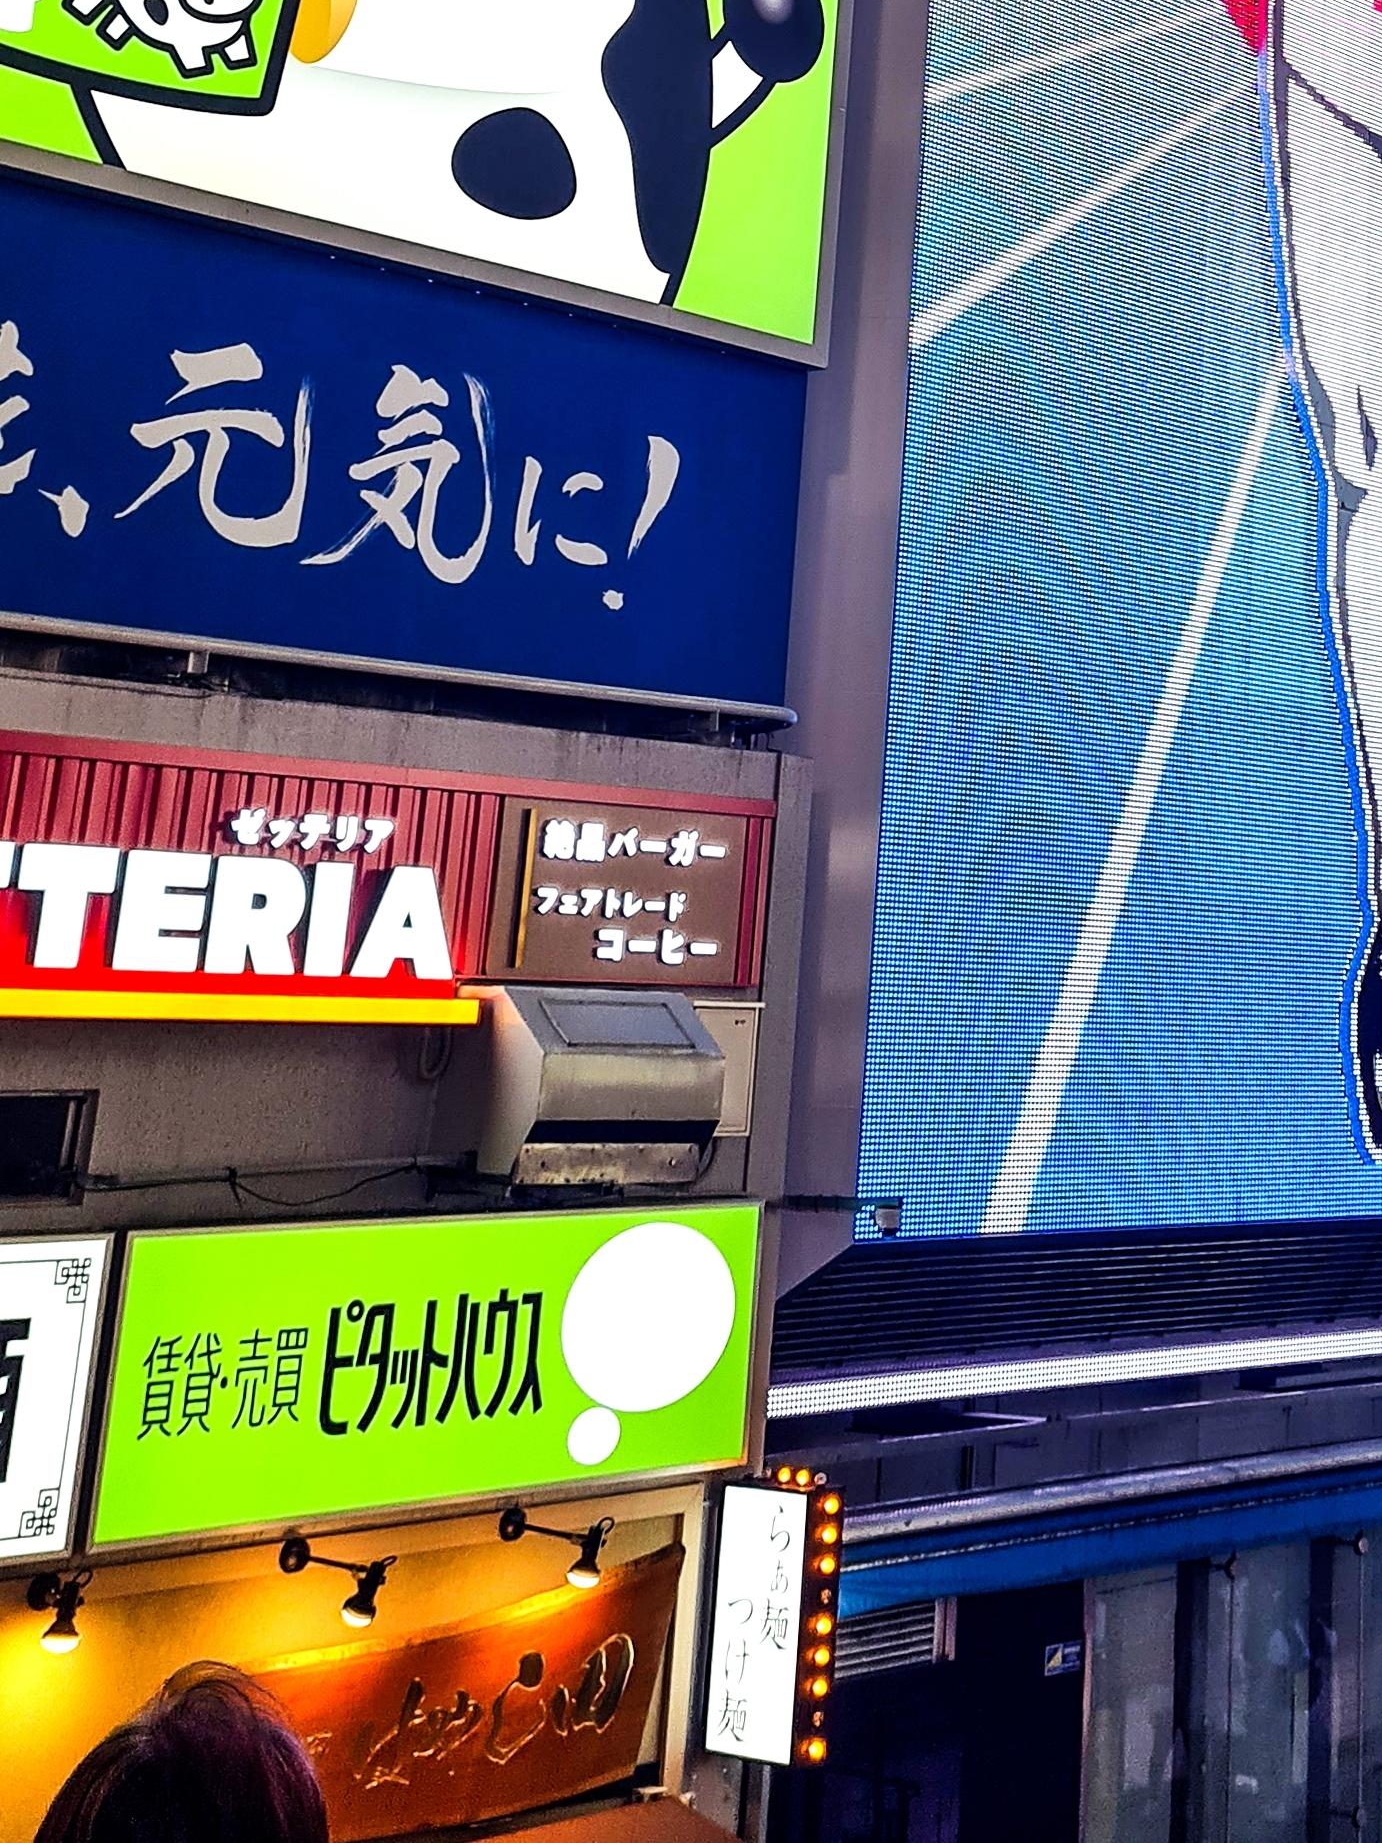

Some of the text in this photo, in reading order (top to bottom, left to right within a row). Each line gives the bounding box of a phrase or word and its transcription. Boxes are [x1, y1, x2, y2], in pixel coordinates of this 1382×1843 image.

[0, 320, 681, 612] 、元気に!
[230, 807, 396, 853] ゼッテリア
[541, 817, 727, 867] 絶品バーガー
[0, 841, 456, 981] TERIA
[534, 886, 687, 922] フェアトレード
[596, 928, 720, 966] コーヒー
[136, 1326, 310, 1443] 賃貸・売買
[317, 1286, 546, 1437] ピタットハウス
[758, 1504, 791, 1651] らぁ麺
[716, 1597, 755, 1743] つけ麺
